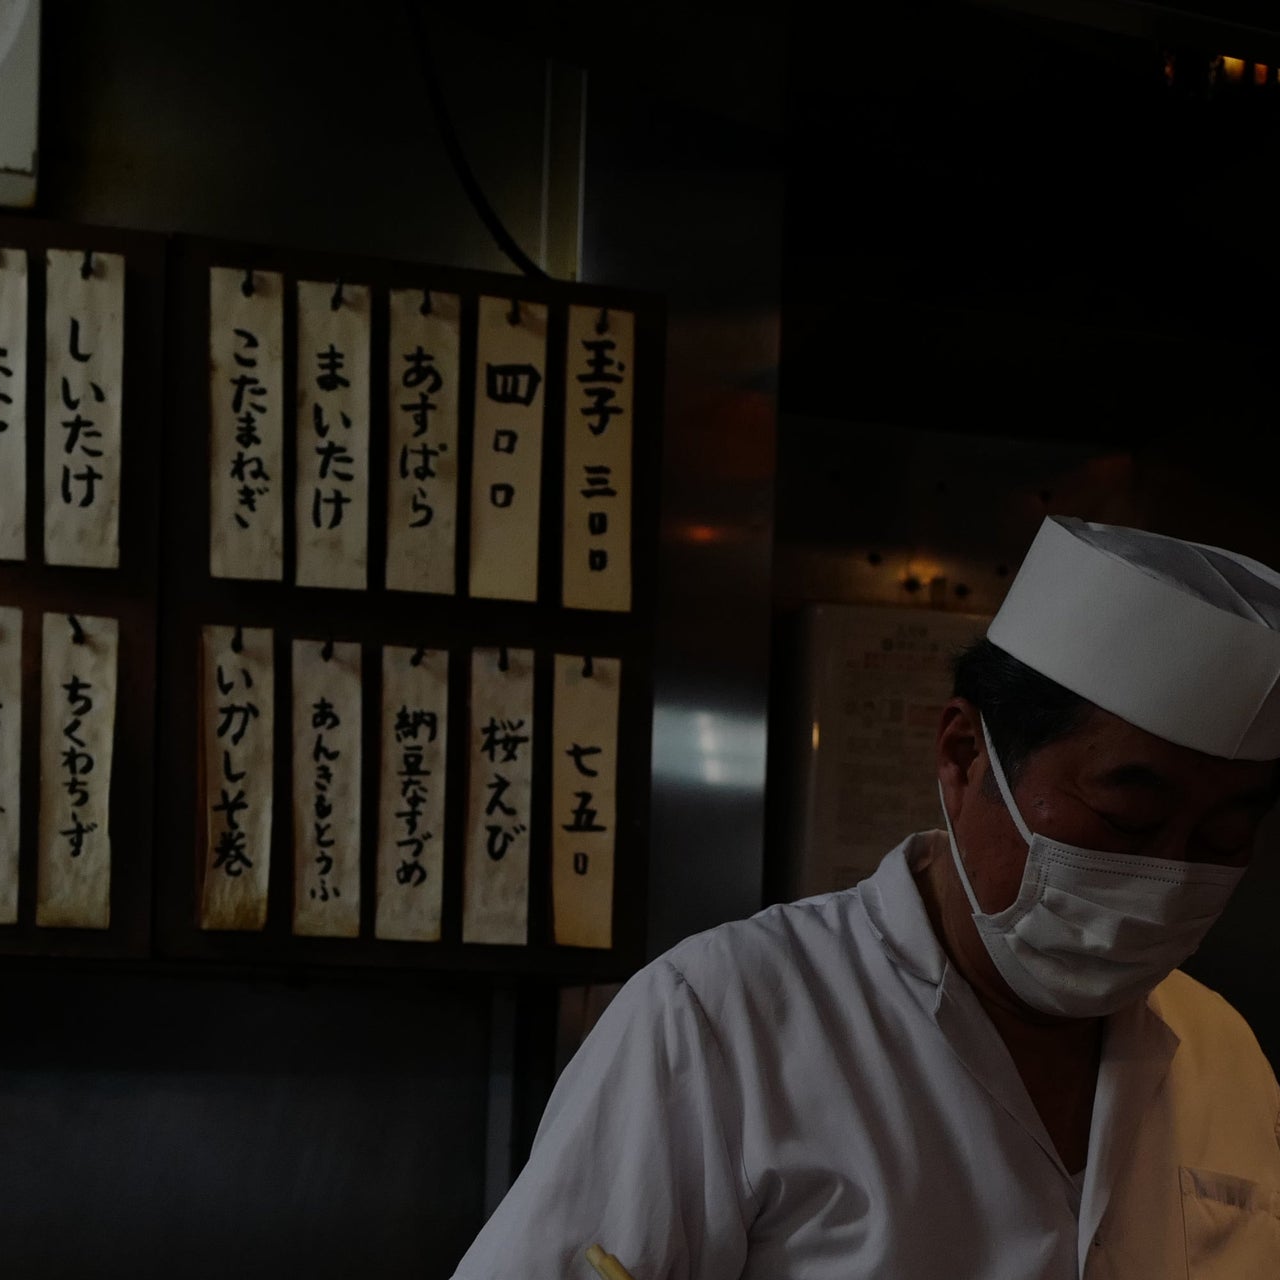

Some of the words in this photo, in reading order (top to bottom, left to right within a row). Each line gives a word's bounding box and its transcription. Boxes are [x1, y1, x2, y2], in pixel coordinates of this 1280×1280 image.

[61, 317, 106, 508] しいたけ
[311, 343, 355, 530] まいたけ
[399, 345, 448, 529] あすぱら
[575, 339, 626, 436] 玉子
[213, 665, 259, 878] いかしそ巻
[309, 696, 341, 902] あんきもとうふ
[481, 716, 528, 861] 桜えび
